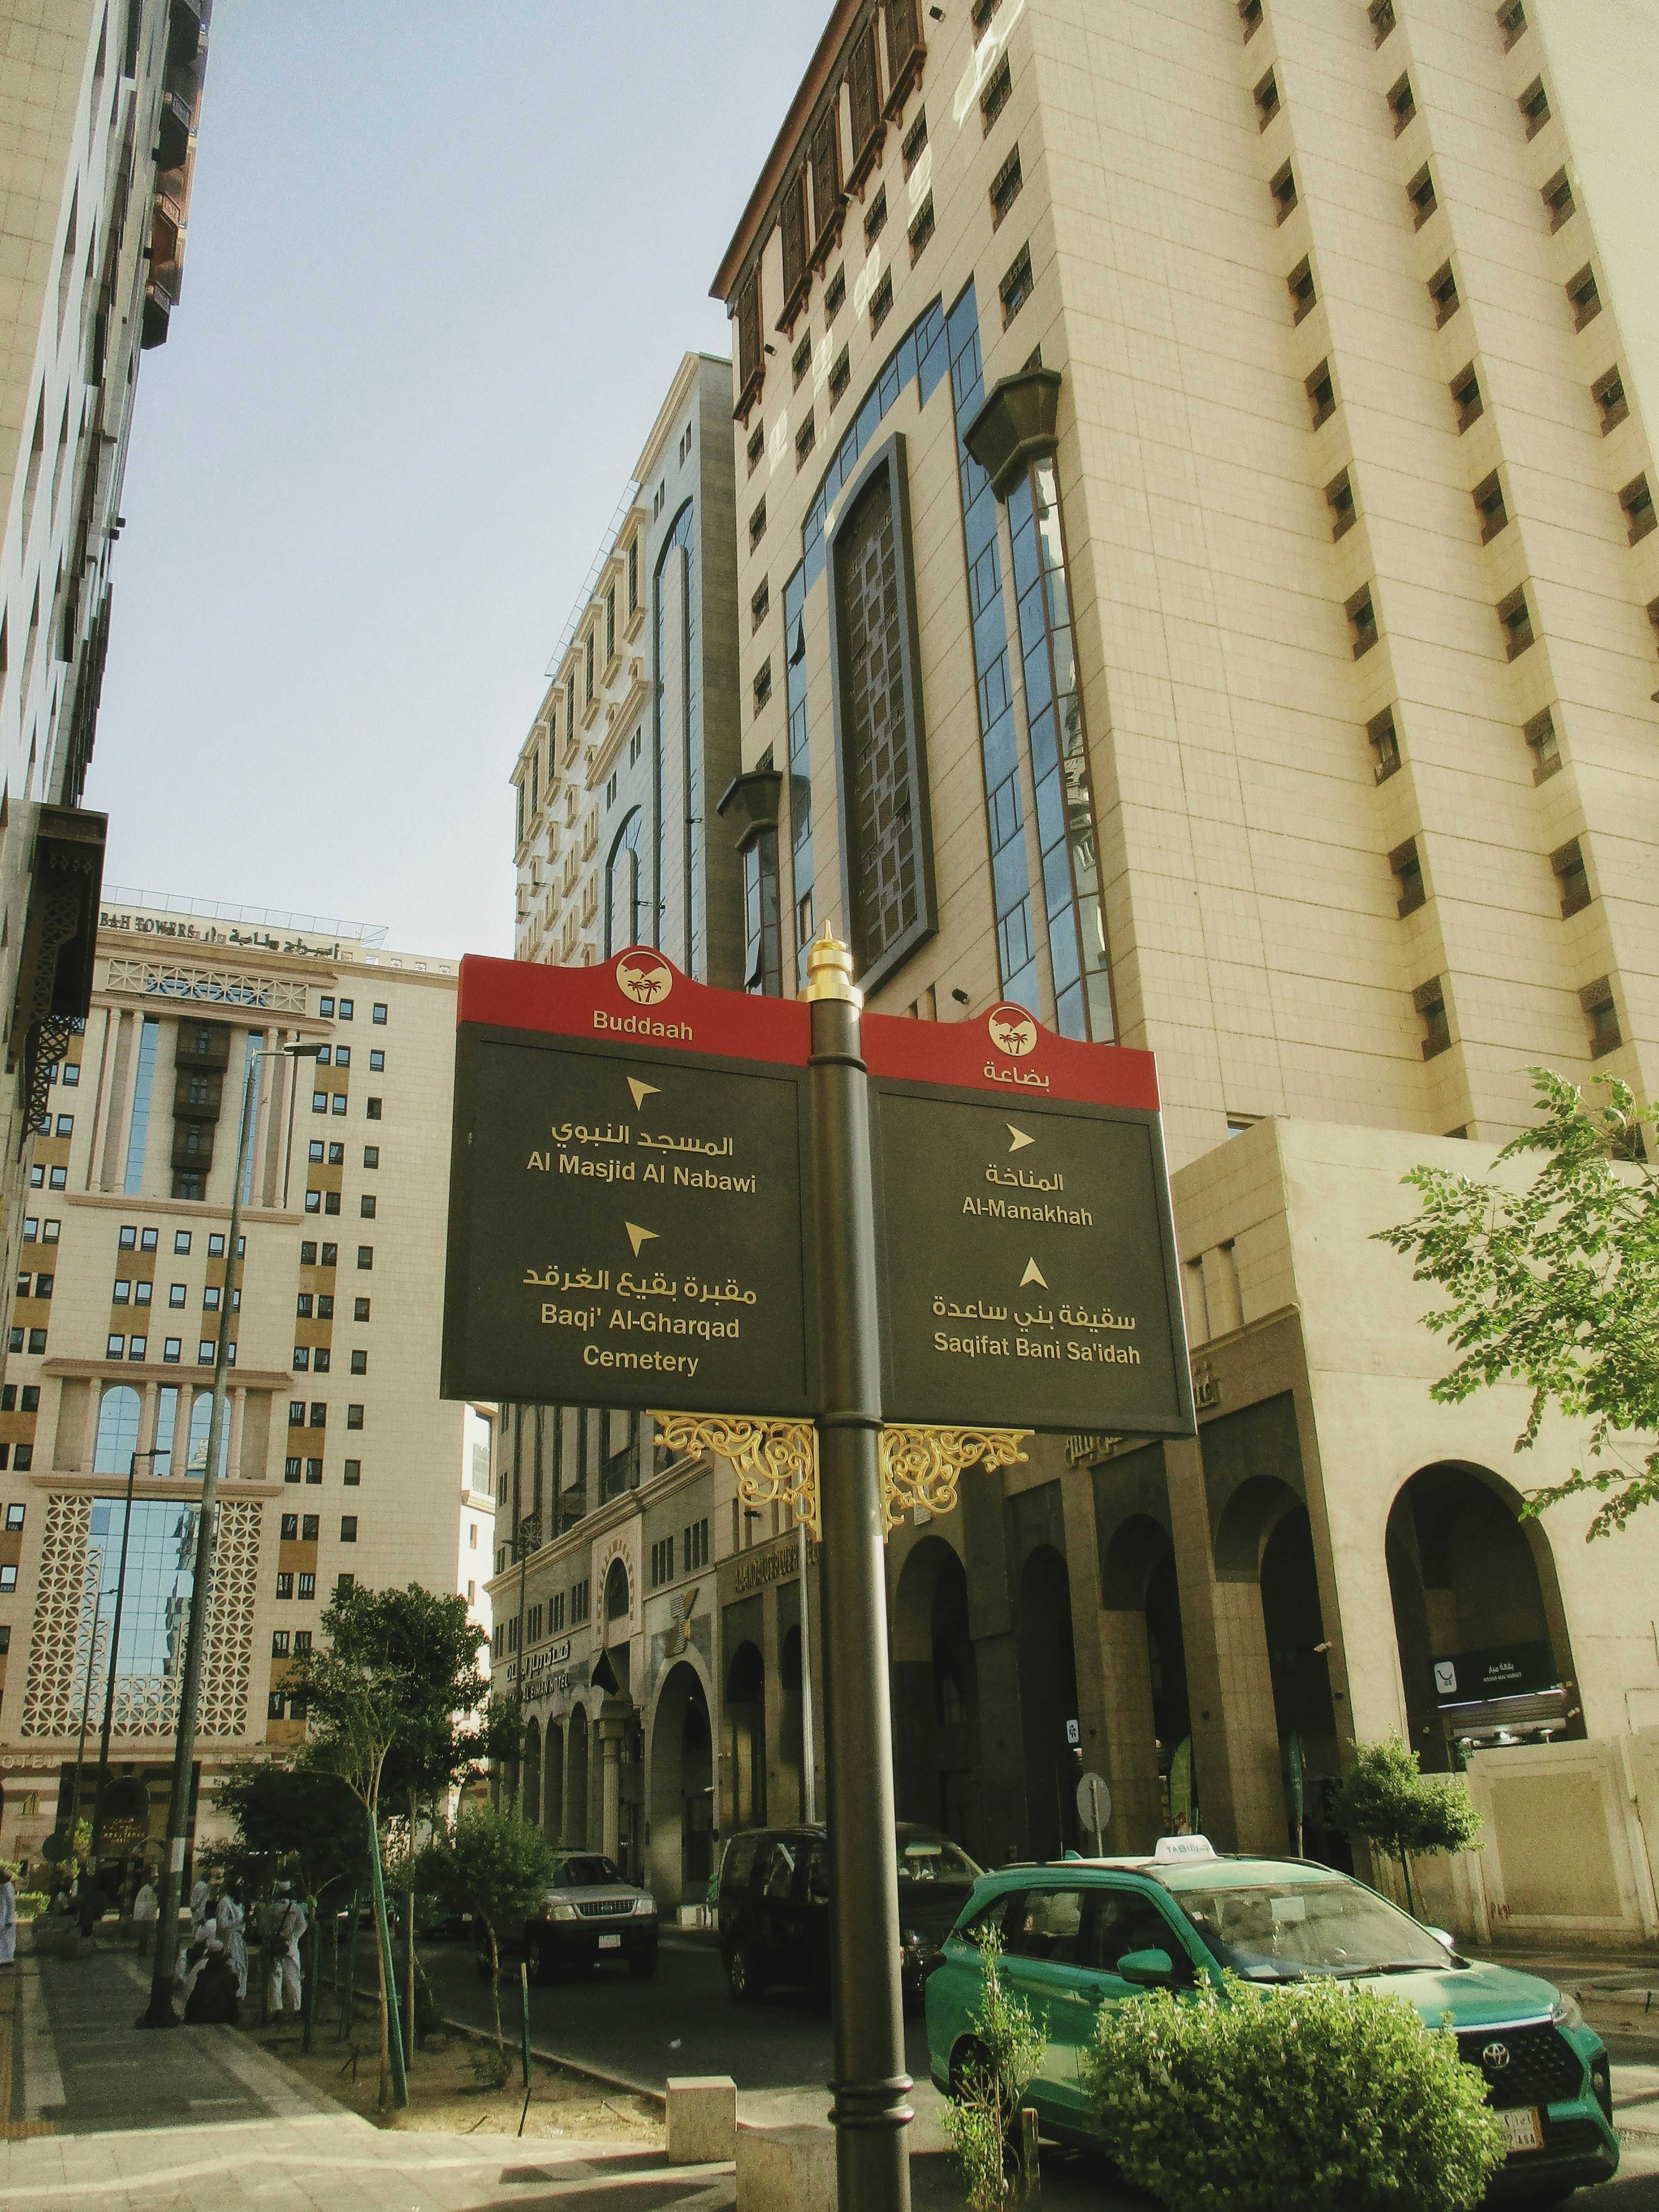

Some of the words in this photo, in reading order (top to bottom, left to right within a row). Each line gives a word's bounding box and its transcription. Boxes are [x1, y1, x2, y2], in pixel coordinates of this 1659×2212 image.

[99, 912, 131, 929] BAH
[134, 916, 196, 939] TOWERS
[592, 1009, 693, 1041] Buddaah
[983, 1060, 1050, 1093] بضاعة
[551, 1121, 630, 1149] النبوي
[637, 1132, 734, 1156] المسجد
[526, 1151, 551, 1171] Al
[559, 1153, 636, 1183] Masjid
[642, 1163, 665, 1184] Al
[674, 1166, 757, 1194] Nabawi
[985, 1163, 1064, 1191] المناخة
[962, 1196, 1093, 1226] Al-Manakhah
[523, 1264, 610, 1291] الغرقد
[616, 1272, 677, 1302] بقيع
[684, 1276, 757, 1307] مقبرة
[541, 1303, 602, 1331] Baqi'
[608, 1309, 740, 1341] Al-Gharqad
[932, 1295, 1008, 1321] ساعدة
[1013, 1305, 1054, 1333] بني
[1058, 1304, 1136, 1334] سقيفة
[583, 1344, 700, 1377] Cemetery
[934, 1331, 1010, 1358] Saqifat
[1015, 1337, 1061, 1359] Bani
[1066, 1341, 1141, 1364] Sa'idah
[530, 1680, 549, 1700] EIMAN
[549, 1672, 569, 1693] HOTEL
[1, 1754, 58, 1769] OTEL
